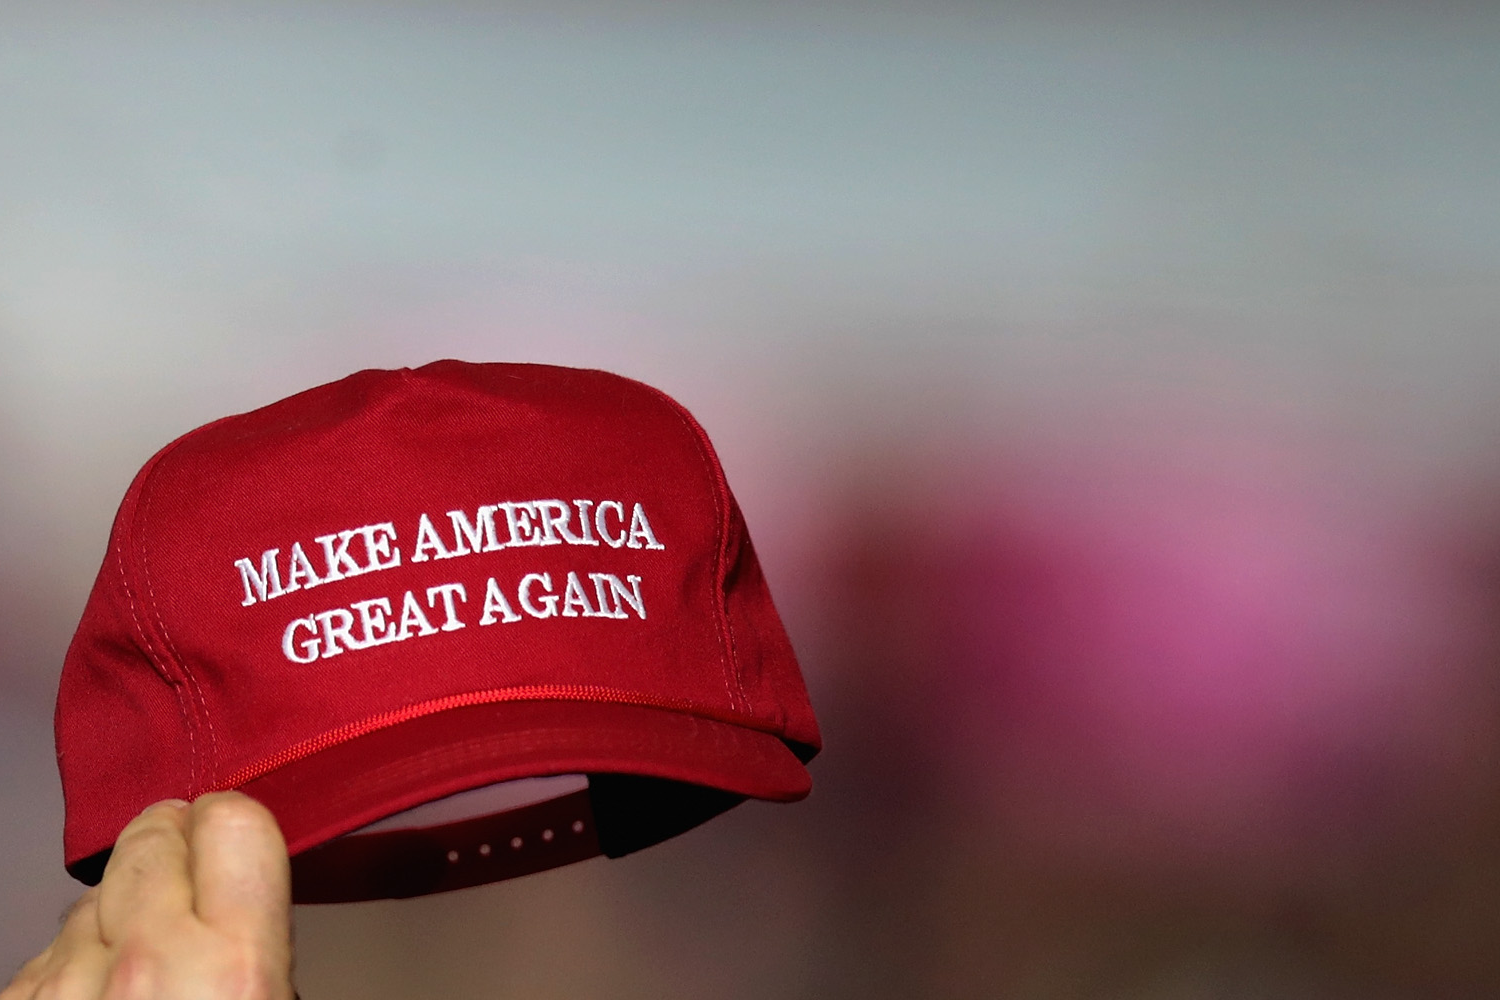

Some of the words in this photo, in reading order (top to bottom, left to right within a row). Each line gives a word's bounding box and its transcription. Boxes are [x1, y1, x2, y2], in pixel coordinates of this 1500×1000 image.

[234, 521, 402, 607] MAKE
[411, 498, 665, 563] AMERICA
[281, 583, 467, 664] GREAT
[479, 571, 647, 626] AGAIN
